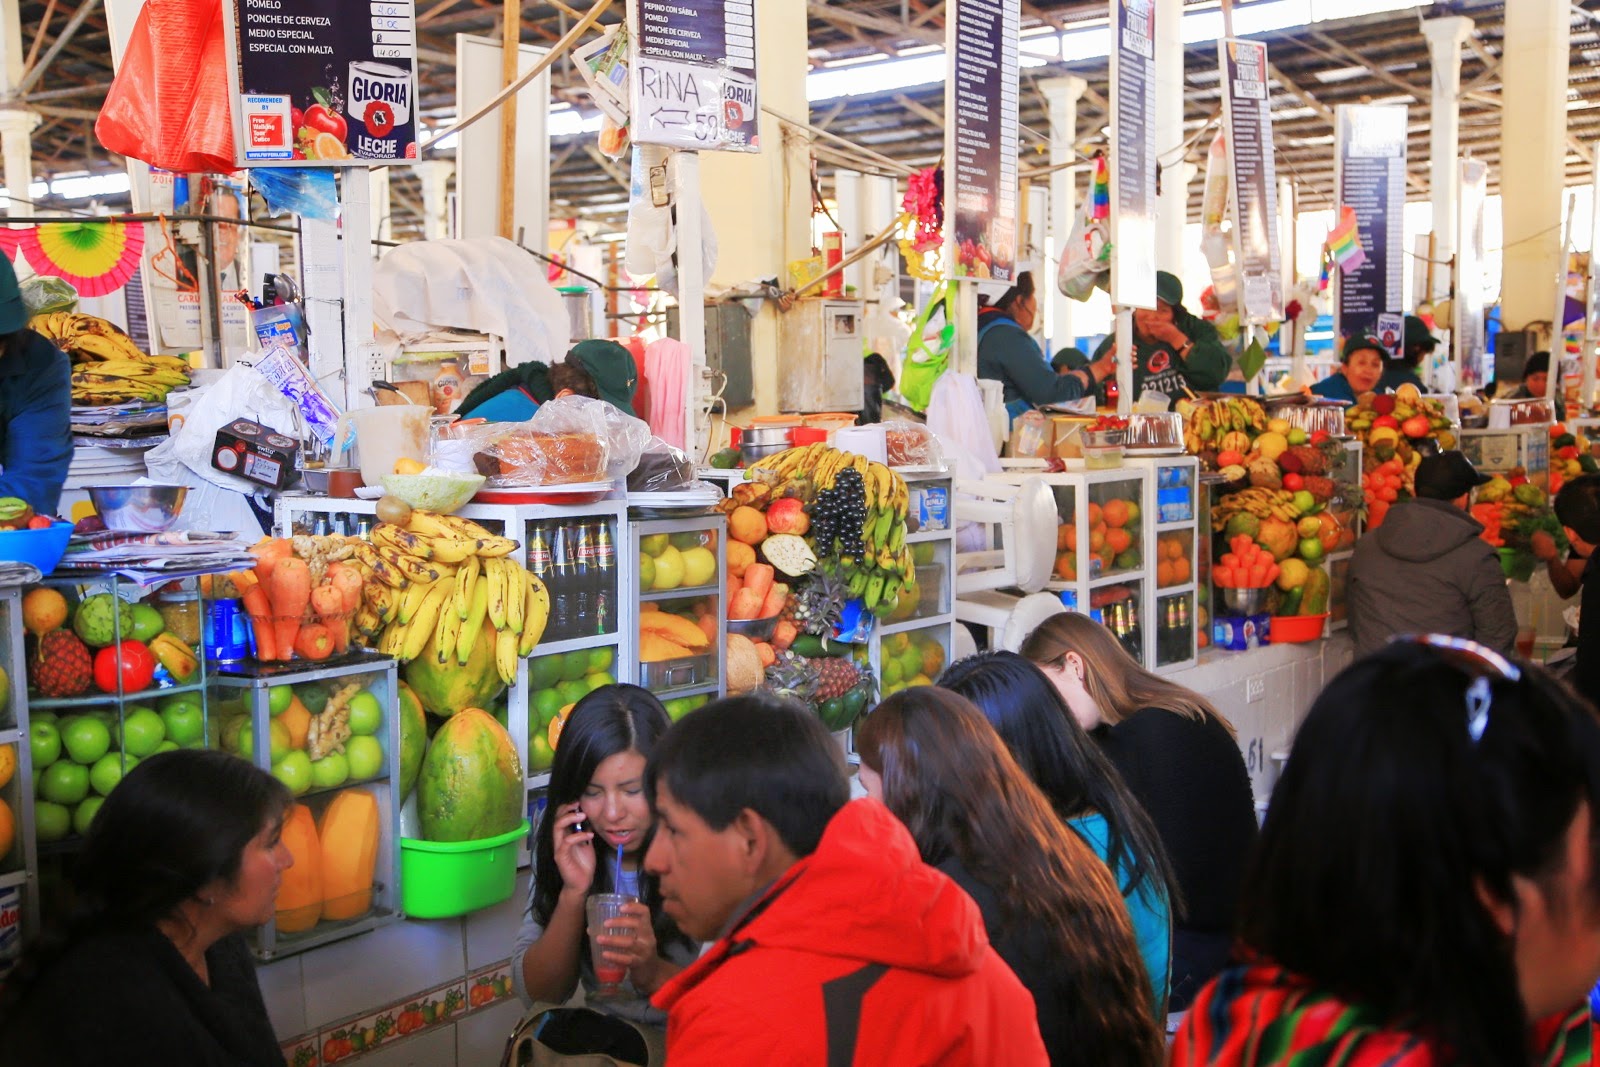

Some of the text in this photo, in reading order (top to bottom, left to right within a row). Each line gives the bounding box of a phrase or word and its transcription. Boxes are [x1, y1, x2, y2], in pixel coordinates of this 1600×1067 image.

[247, 0, 281, 9] POMELO
[644, 2, 697, 17] PEPINO CON SÁBILA
[247, 14, 331, 26] PONCHE DE CERVEZA
[645, 13, 668, 23] POMELO
[248, 28, 314, 40] MEDIO ESPECIAL
[645, 24, 701, 39] PONCHE DE CERVEZA
[645, 36, 690, 48] MEDIO ESPECIAL
[249, 43, 334, 55] ESPECIAL CON MALTA
[645, 47, 703, 61] ESPECIAL CON MALTA
[352, 77, 407, 109] GLORIA
[639, 67, 701, 106] RINA
[358, 135, 397, 154] LECHE
[152, 175, 173, 184] 2014
[1247, 737, 1263, 773] 61
